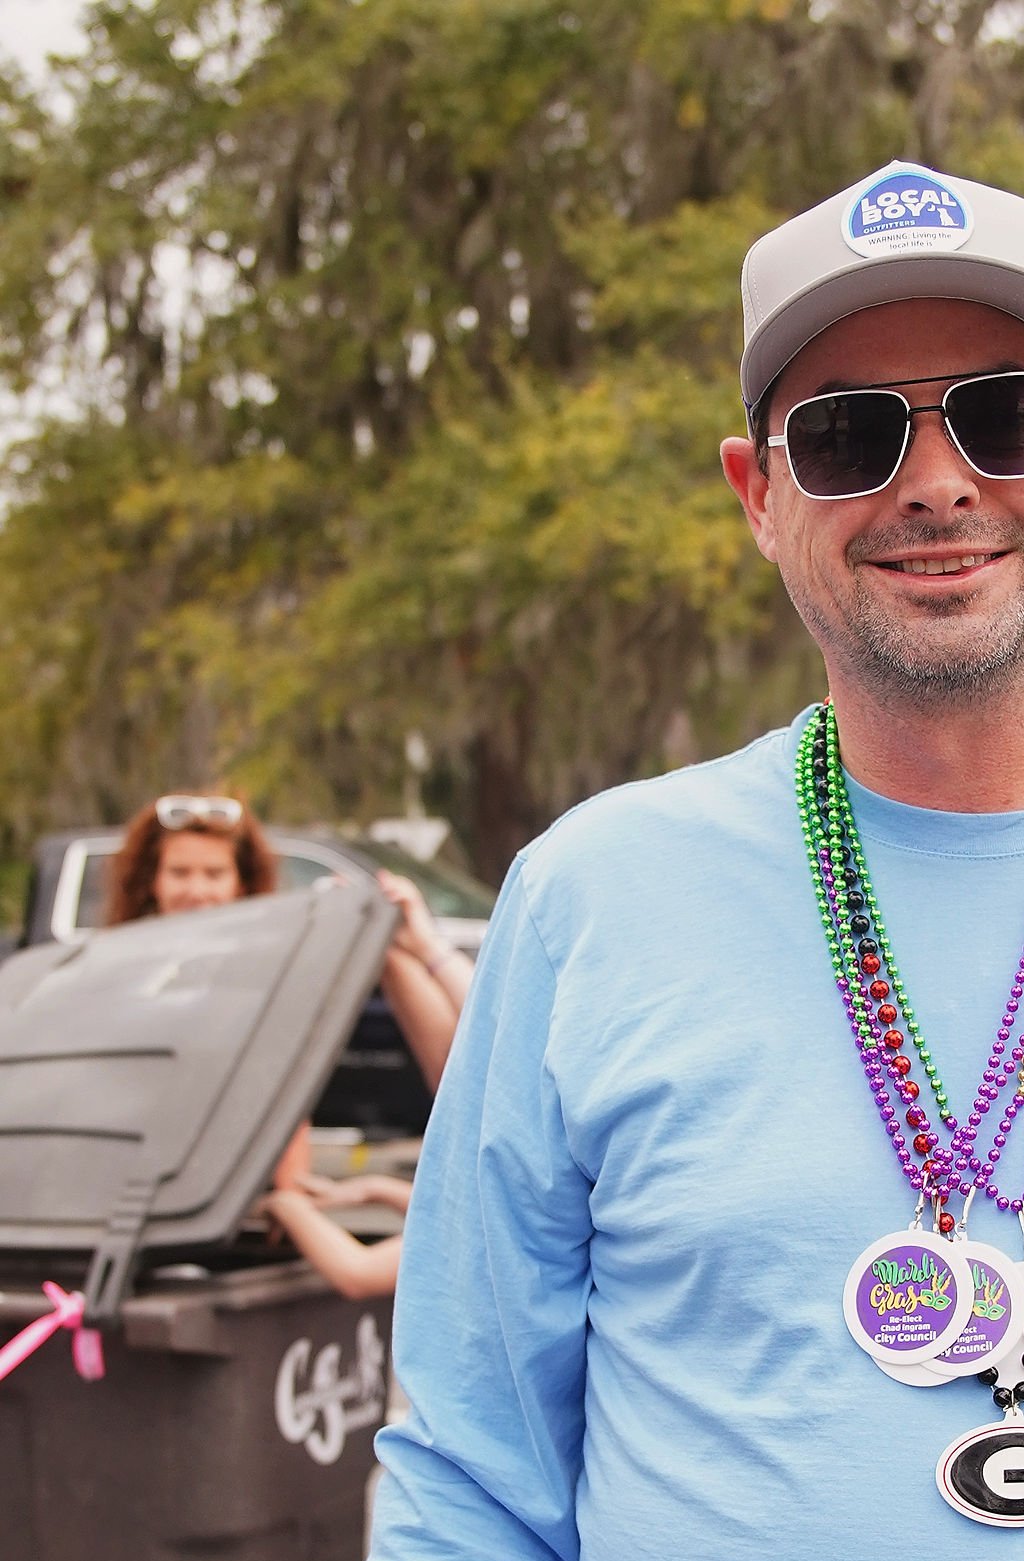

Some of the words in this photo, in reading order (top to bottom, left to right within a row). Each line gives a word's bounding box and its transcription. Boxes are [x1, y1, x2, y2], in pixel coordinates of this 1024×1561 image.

[861, 189, 957, 212] LOCAL
[862, 203, 926, 225] BOY
[863, 219, 916, 234] OUTFITTERS
[912, 231, 937, 241] Living
[938, 231, 952, 239] the
[889, 241, 909, 250] local
[911, 240, 924, 248] life
[873, 1252, 936, 1287] Mardi
[870, 1284, 921, 1316] Gras
[889, 1315, 922, 1324] Re-Elect
[880, 1324, 901, 1332] Chad
[902, 1323, 931, 1332] Ingram
[874, 1332, 896, 1345] City
[897, 1331, 937, 1342] Council
[953, 1341, 993, 1354] Council
